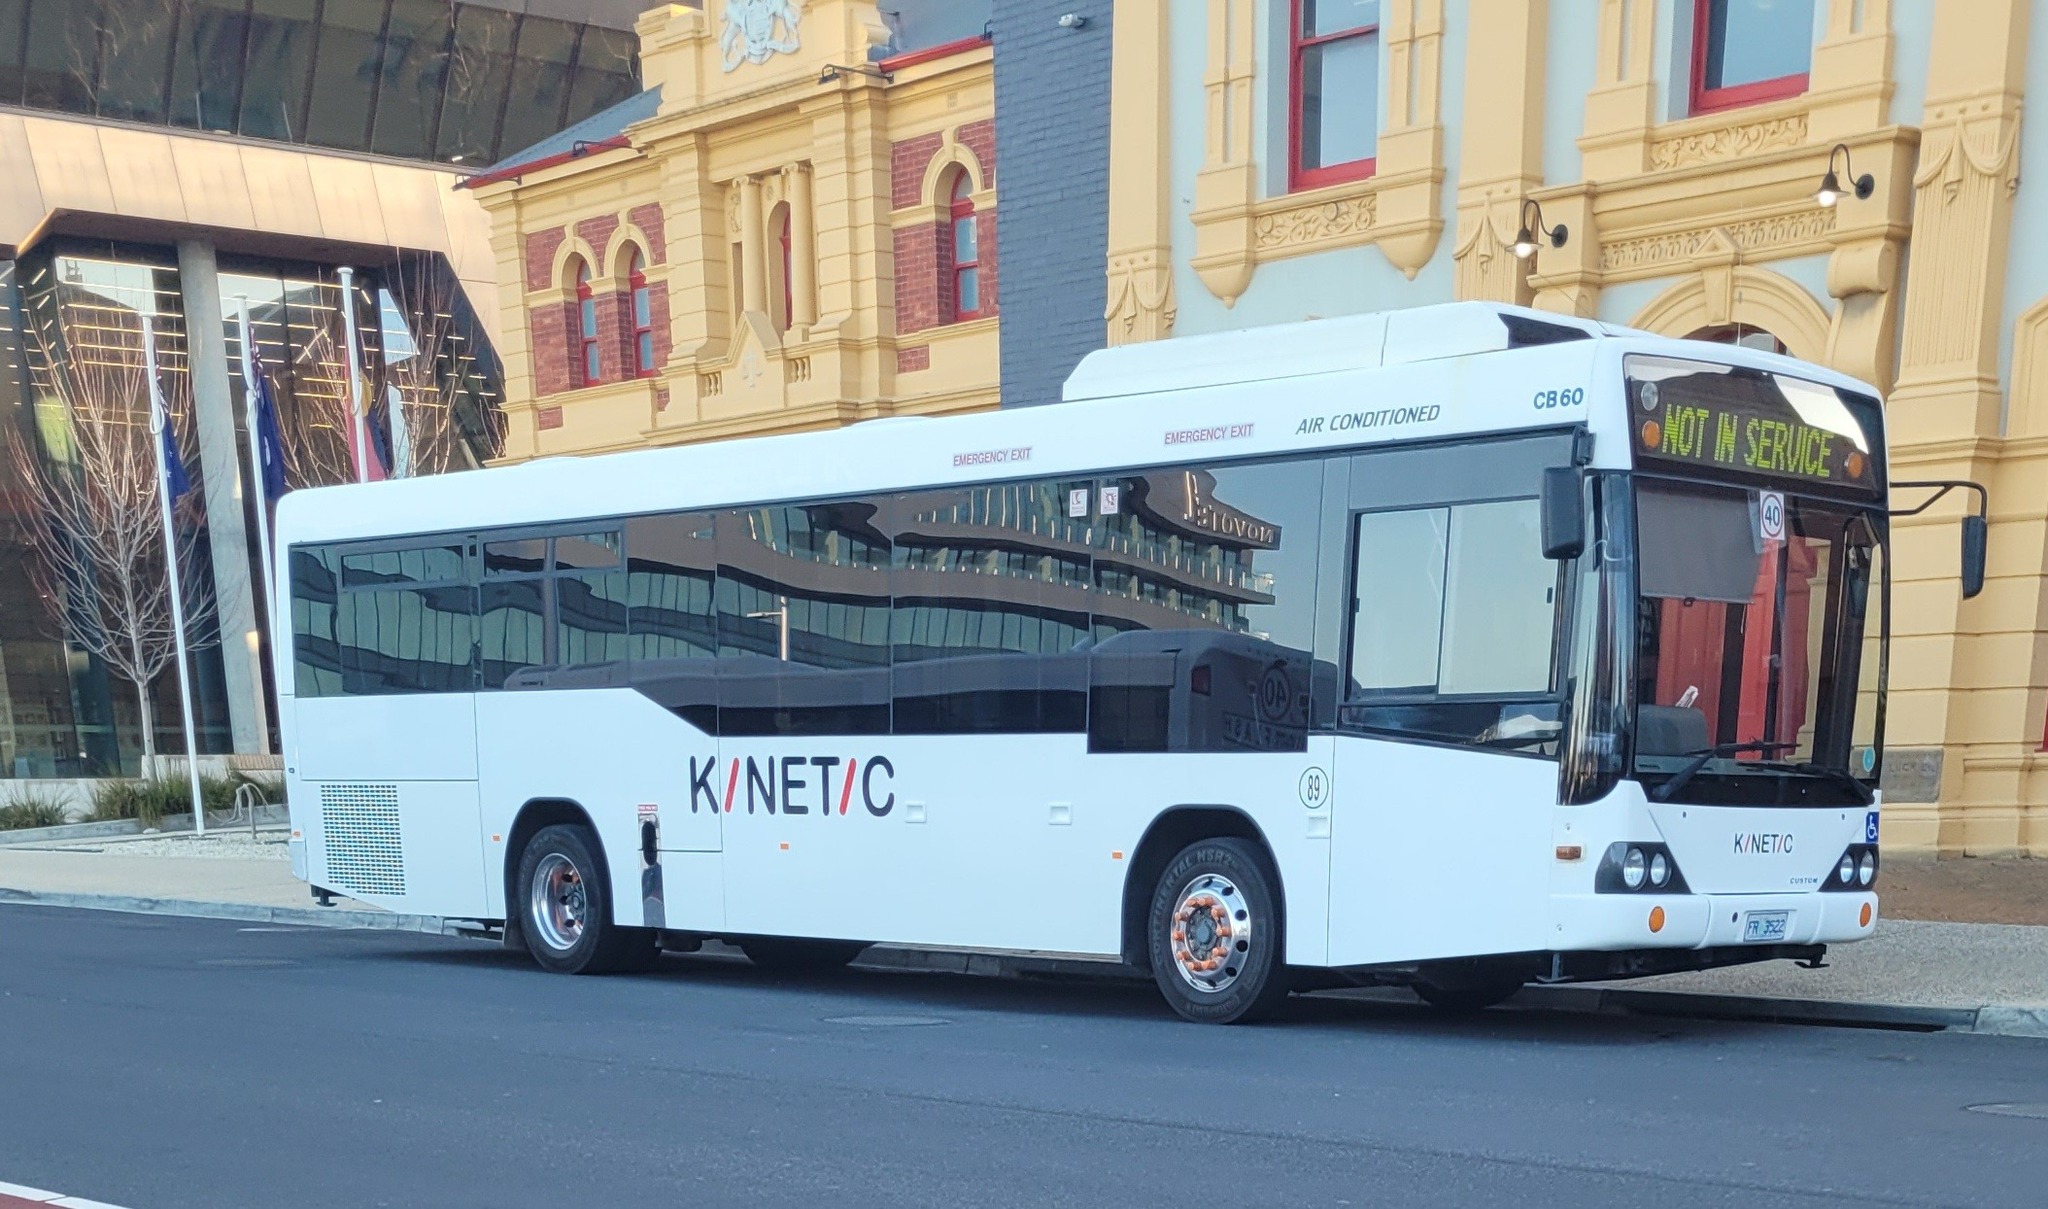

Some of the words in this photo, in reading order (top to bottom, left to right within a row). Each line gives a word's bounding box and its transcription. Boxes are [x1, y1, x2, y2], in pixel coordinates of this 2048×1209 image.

[1534, 387, 1584, 410] CB60
[1295, 416, 1325, 435] AIR
[1329, 404, 1441, 431] CONDITIONED
[1164, 428, 1227, 445] EMERGENCY
[1230, 425, 1253, 439] EXIT
[1662, 403, 1710, 459] NOT
[1714, 412, 1739, 464] IN
[1744, 418, 1834, 478] SERVICE
[953, 449, 1008, 466] EMERGENCY
[1010, 447, 1032, 461] EXIT
[1764, 505, 1780, 527] 40
[690, 755, 895, 817] KINETIC
[1307, 774, 1320, 801] 89
[1734, 833, 1793, 853] KINETIC
